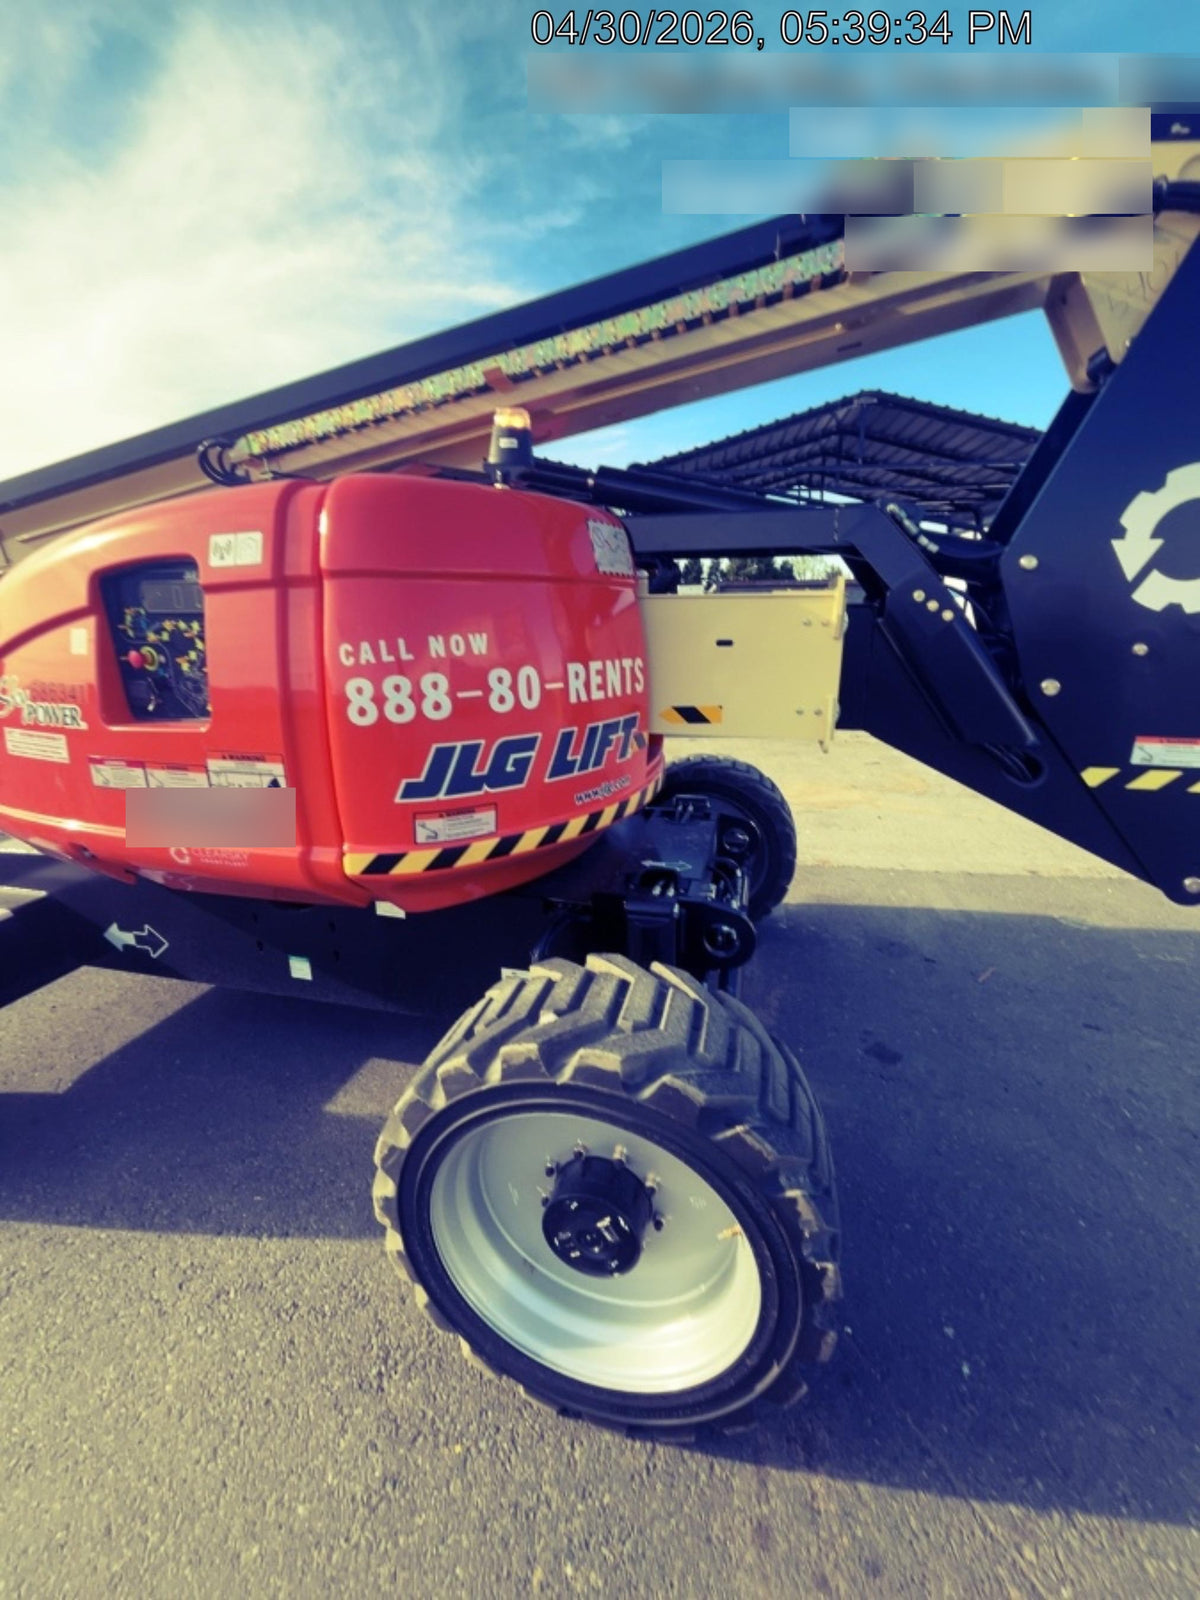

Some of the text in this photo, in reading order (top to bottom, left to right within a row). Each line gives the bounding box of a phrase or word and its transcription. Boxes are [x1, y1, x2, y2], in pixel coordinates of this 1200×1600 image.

[339, 632, 489, 667] CALL NOW
[344, 657, 645, 727] 888-80-RENTS
[394, 712, 641, 803] JLG LIFT
